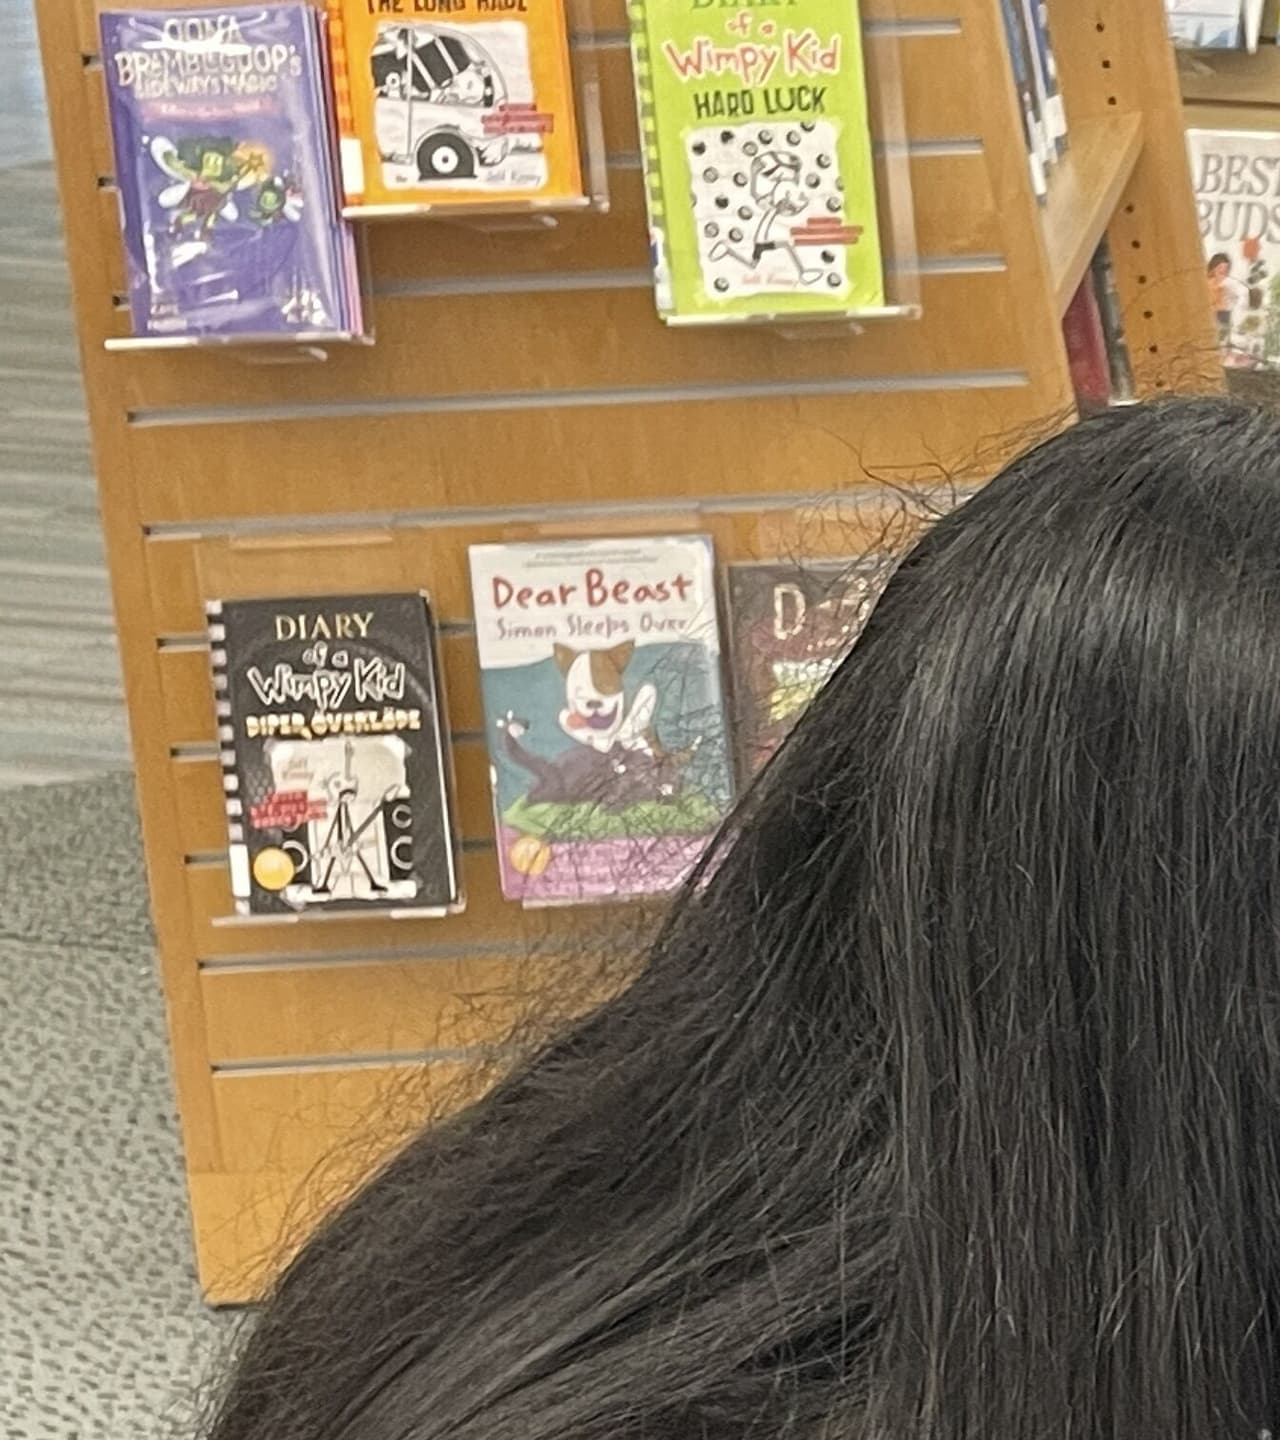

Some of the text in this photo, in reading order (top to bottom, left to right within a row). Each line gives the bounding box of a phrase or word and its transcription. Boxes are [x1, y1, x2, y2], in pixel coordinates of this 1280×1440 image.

[726, 12, 776, 36] of a
[663, 30, 840, 85] Wimpy Kid
[693, 85, 828, 120] HARD LUCK
[491, 567, 693, 611] Dear Beast
[275, 612, 374, 641] DIARY
[497, 612, 688, 641] Simon Sleeps Over
[302, 641, 349, 668] of a
[247, 657, 405, 710] Wimpy Kid
